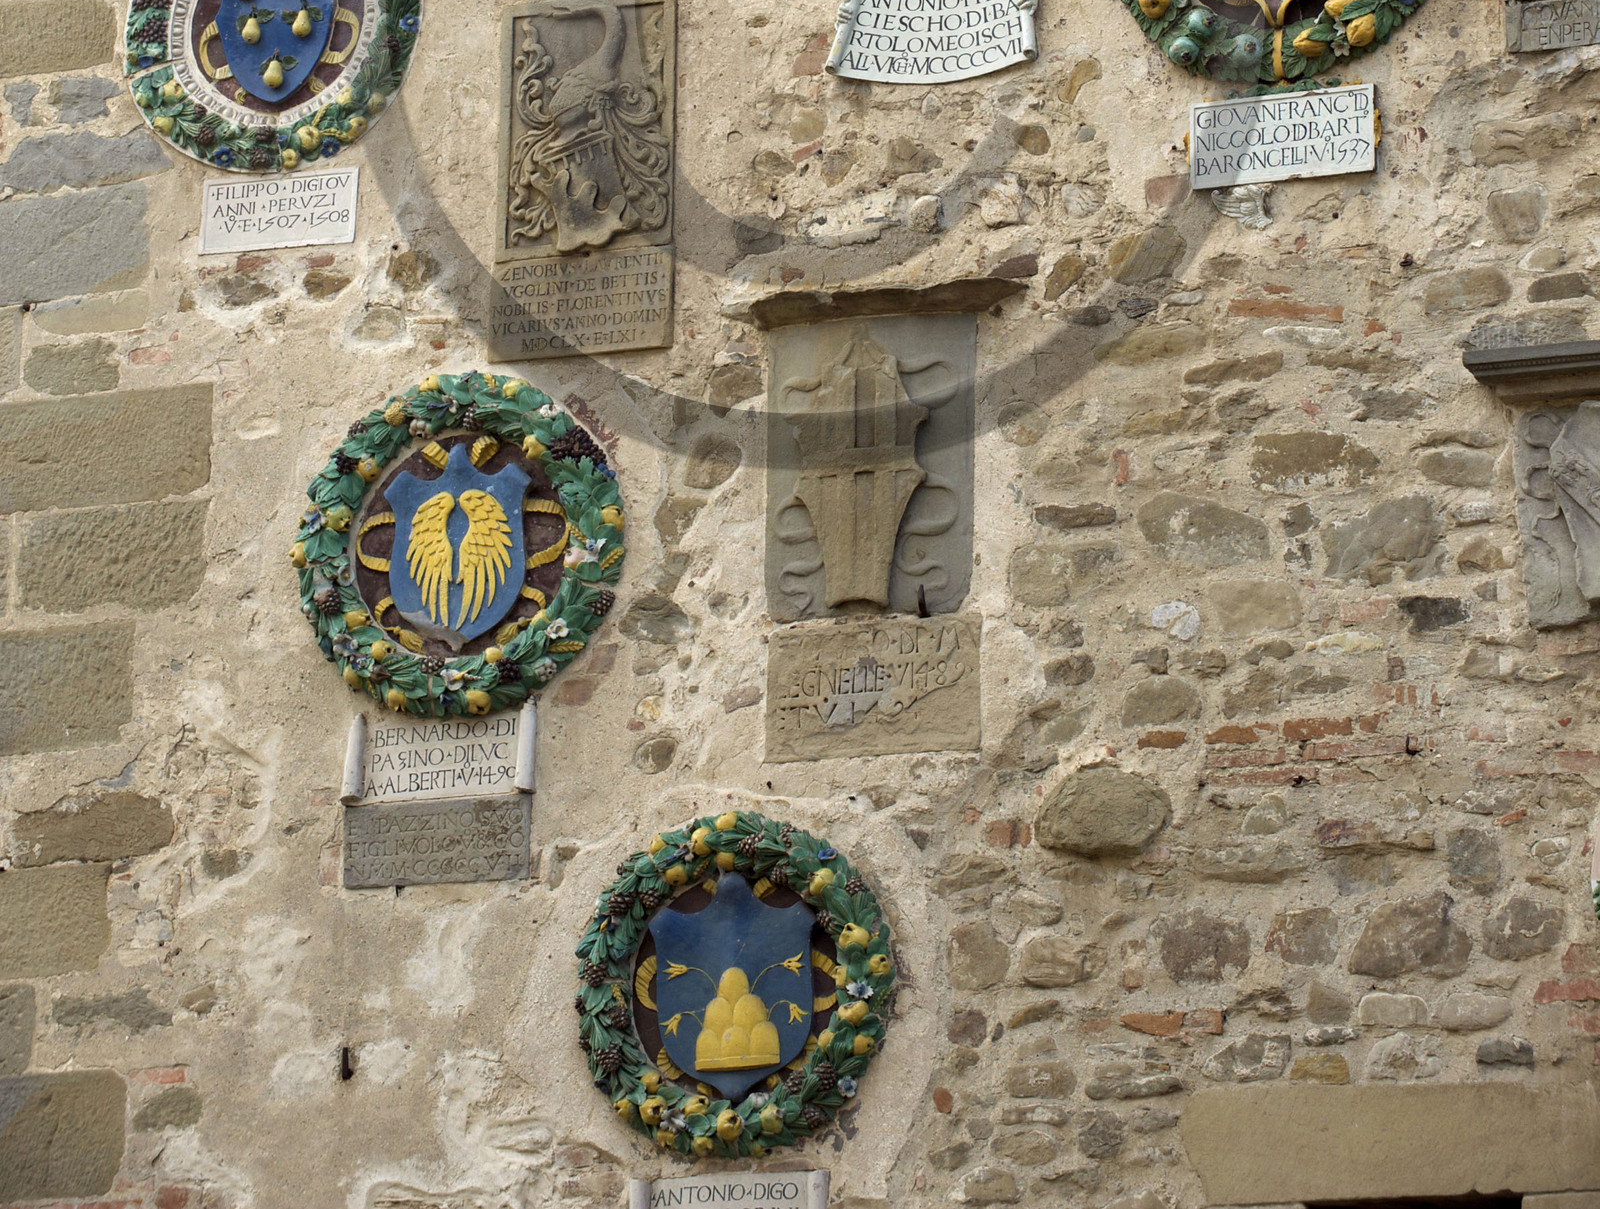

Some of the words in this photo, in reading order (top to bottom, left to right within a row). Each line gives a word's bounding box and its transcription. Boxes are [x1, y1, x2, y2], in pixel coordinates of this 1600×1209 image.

[855, 11, 962, 33] CIESCHO
[965, 8, 988, 29] DI
[1332, 138, 1371, 166] 1537
[215, 182, 279, 201] FILIPPO
[213, 202, 256, 219] ANNI
[269, 193, 336, 213] PERVZI
[242, 218, 252, 232] E
[257, 214, 300, 234] 1507
[310, 209, 350, 229] 1508
[500, 263, 576, 281] ZENOBIVS
[502, 281, 569, 299] VGOLINI
[576, 278, 596, 293] DE
[601, 271, 659, 290] BETTIS
[492, 300, 549, 318] NOBILIS
[556, 288, 667, 313] FLORENTINVS
[491, 317, 562, 336] VICARIVS
[564, 314, 608, 330] ANNO
[612, 308, 668, 326] DOMINI
[609, 328, 636, 344] LXI
[374, 721, 488, 749] BERNARDO
[495, 718, 517, 736] DI
[364, 779, 378, 798] A
[382, 770, 456, 796] ALBERTI
[654, 1182, 746, 1207] ANTONIO
